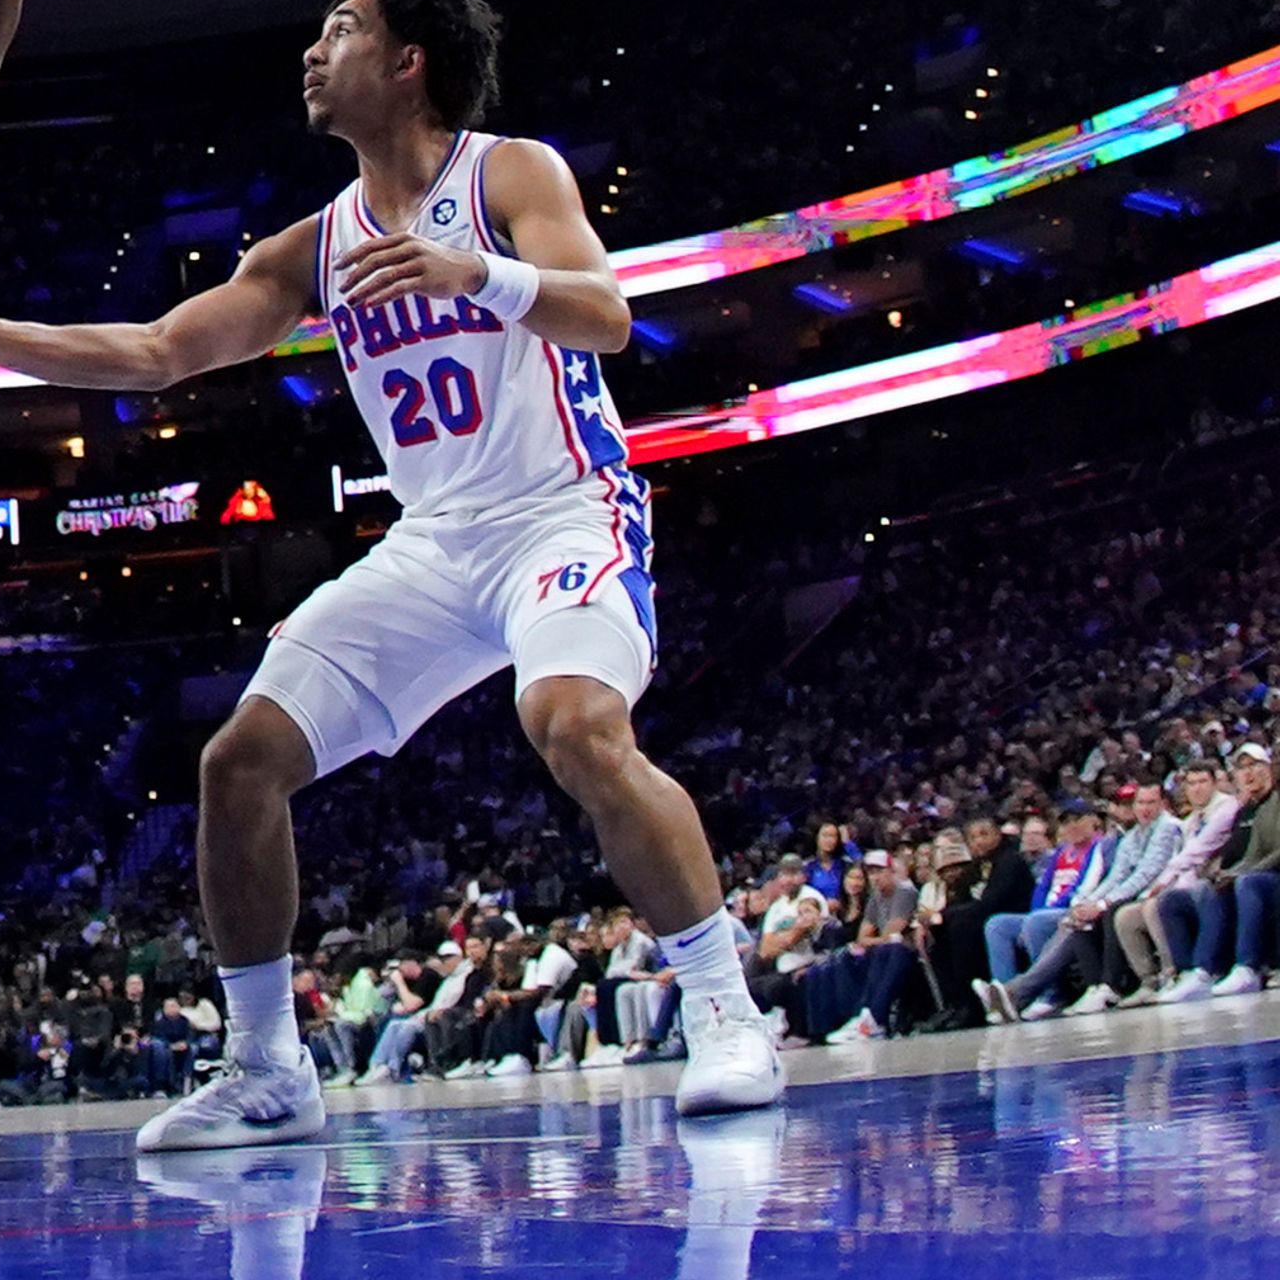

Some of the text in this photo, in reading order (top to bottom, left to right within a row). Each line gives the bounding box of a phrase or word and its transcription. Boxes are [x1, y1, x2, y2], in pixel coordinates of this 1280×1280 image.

[329, 292, 504, 373] PHILA
[382, 356, 483, 448] 20
[536, 561, 588, 602] 76
